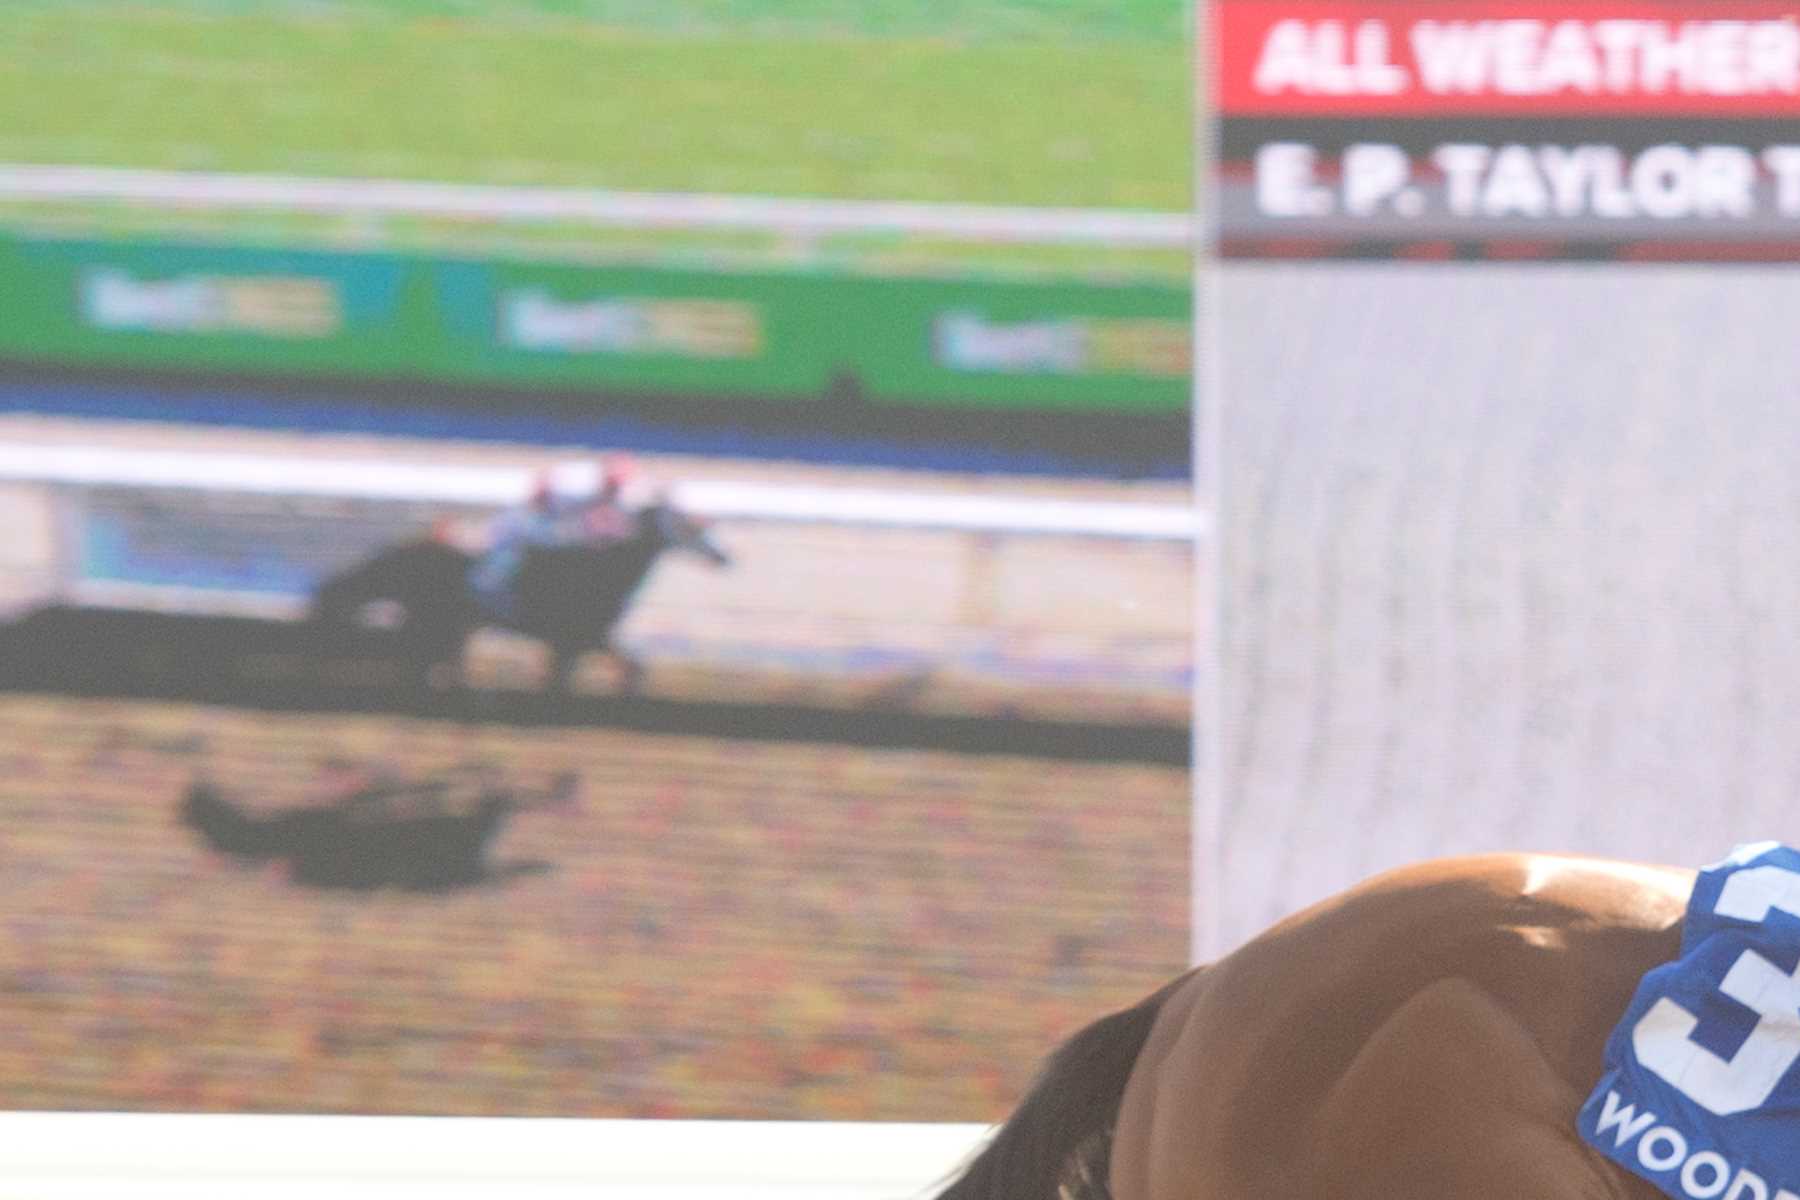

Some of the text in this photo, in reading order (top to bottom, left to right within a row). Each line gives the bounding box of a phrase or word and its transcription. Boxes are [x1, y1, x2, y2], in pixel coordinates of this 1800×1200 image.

[1255, 21, 1403, 95] ALL
[1256, 143, 1332, 218] E.
[1341, 144, 1425, 218] P.
[1434, 144, 1754, 219] TAYLOR
